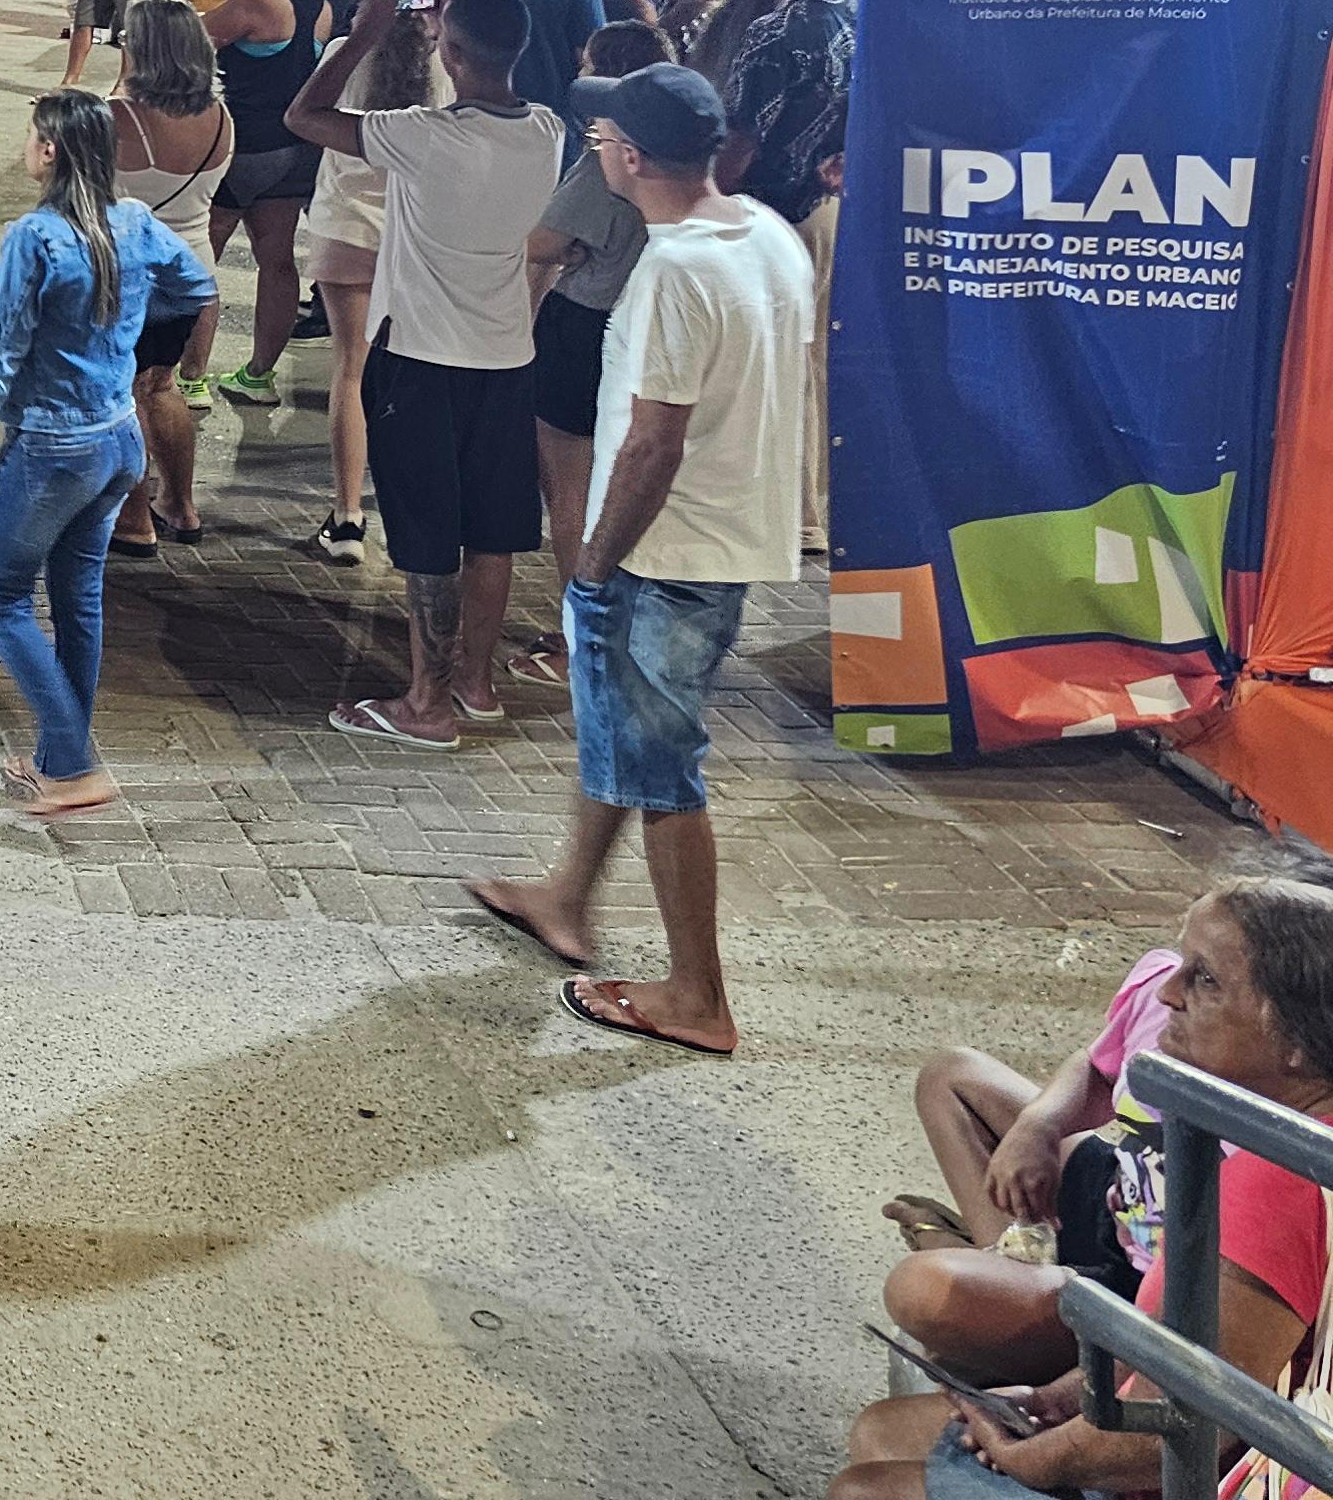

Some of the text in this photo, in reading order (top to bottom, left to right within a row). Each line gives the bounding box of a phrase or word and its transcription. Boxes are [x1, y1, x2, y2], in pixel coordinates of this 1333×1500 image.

[968, 8, 1022, 20] Urbano
[1047, 6, 1121, 20] Prefeitura
[1124, 5, 1144, 19] de
[1148, 6, 1206, 20] Maceió
[901, 148, 1256, 227] IPLAN
[904, 227, 1244, 262] INSTITUTO DE PESQUISA
[904, 252, 919, 268] E
[927, 252, 1130, 281] PLANEJAMENTO
[905, 276, 941, 292] DA
[947, 279, 1100, 306] PREFEITURA
[1106, 289, 1140, 307] DE
